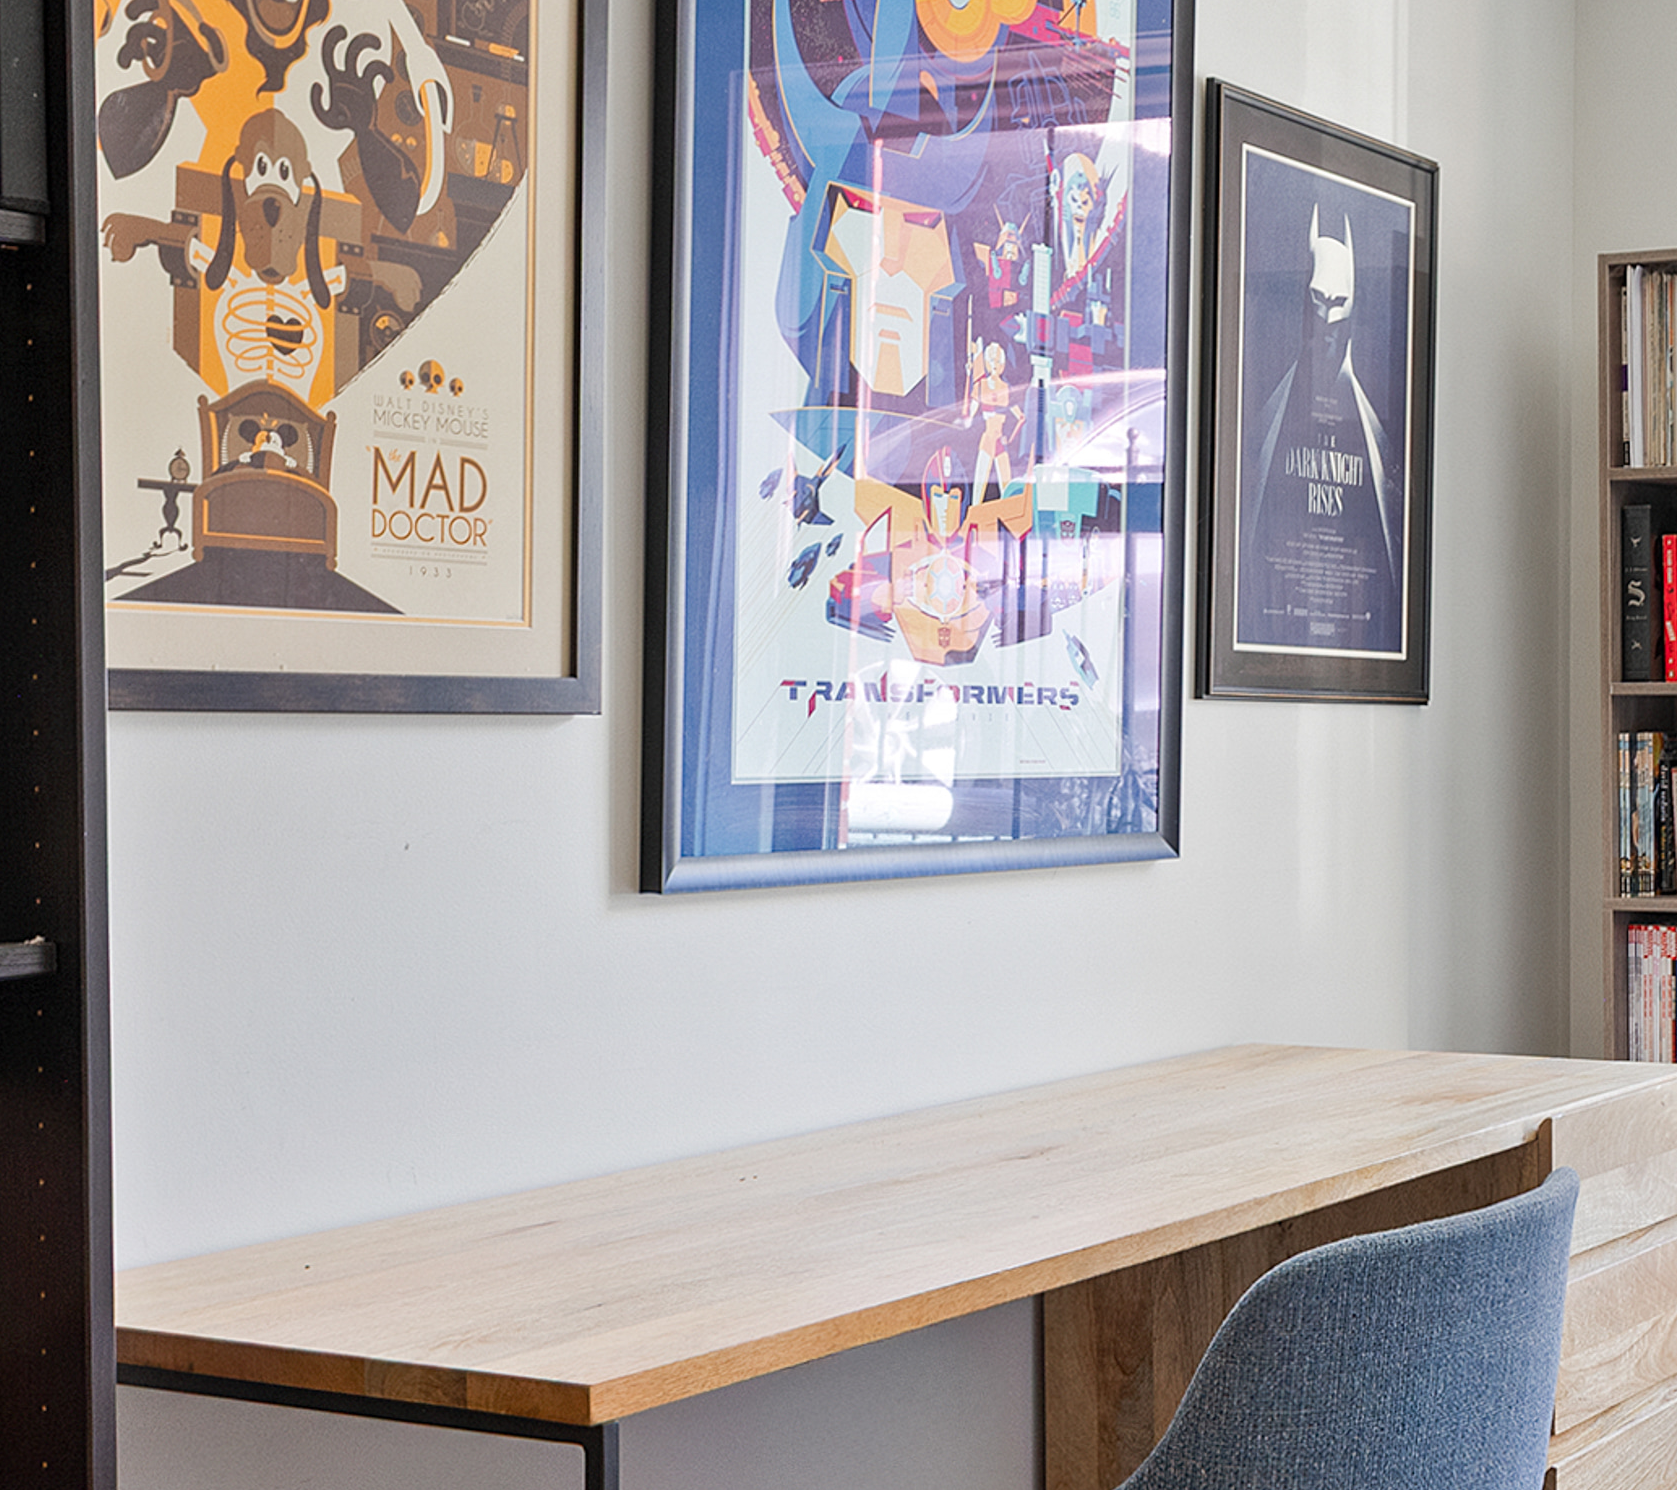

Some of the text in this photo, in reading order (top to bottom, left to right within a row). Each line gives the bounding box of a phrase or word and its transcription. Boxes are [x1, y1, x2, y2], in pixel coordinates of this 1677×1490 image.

[374, 394, 489, 421] WALT DISNEY'S
[374, 408, 489, 439] MICKEY MOUSE
[372, 445, 489, 513] MAD
[1285, 446, 1365, 487] DARK KNIGHT
[1307, 482, 1344, 517] RISES
[409, 565, 453, 579] 1933
[780, 671, 1080, 718] TRANSFORMERS
